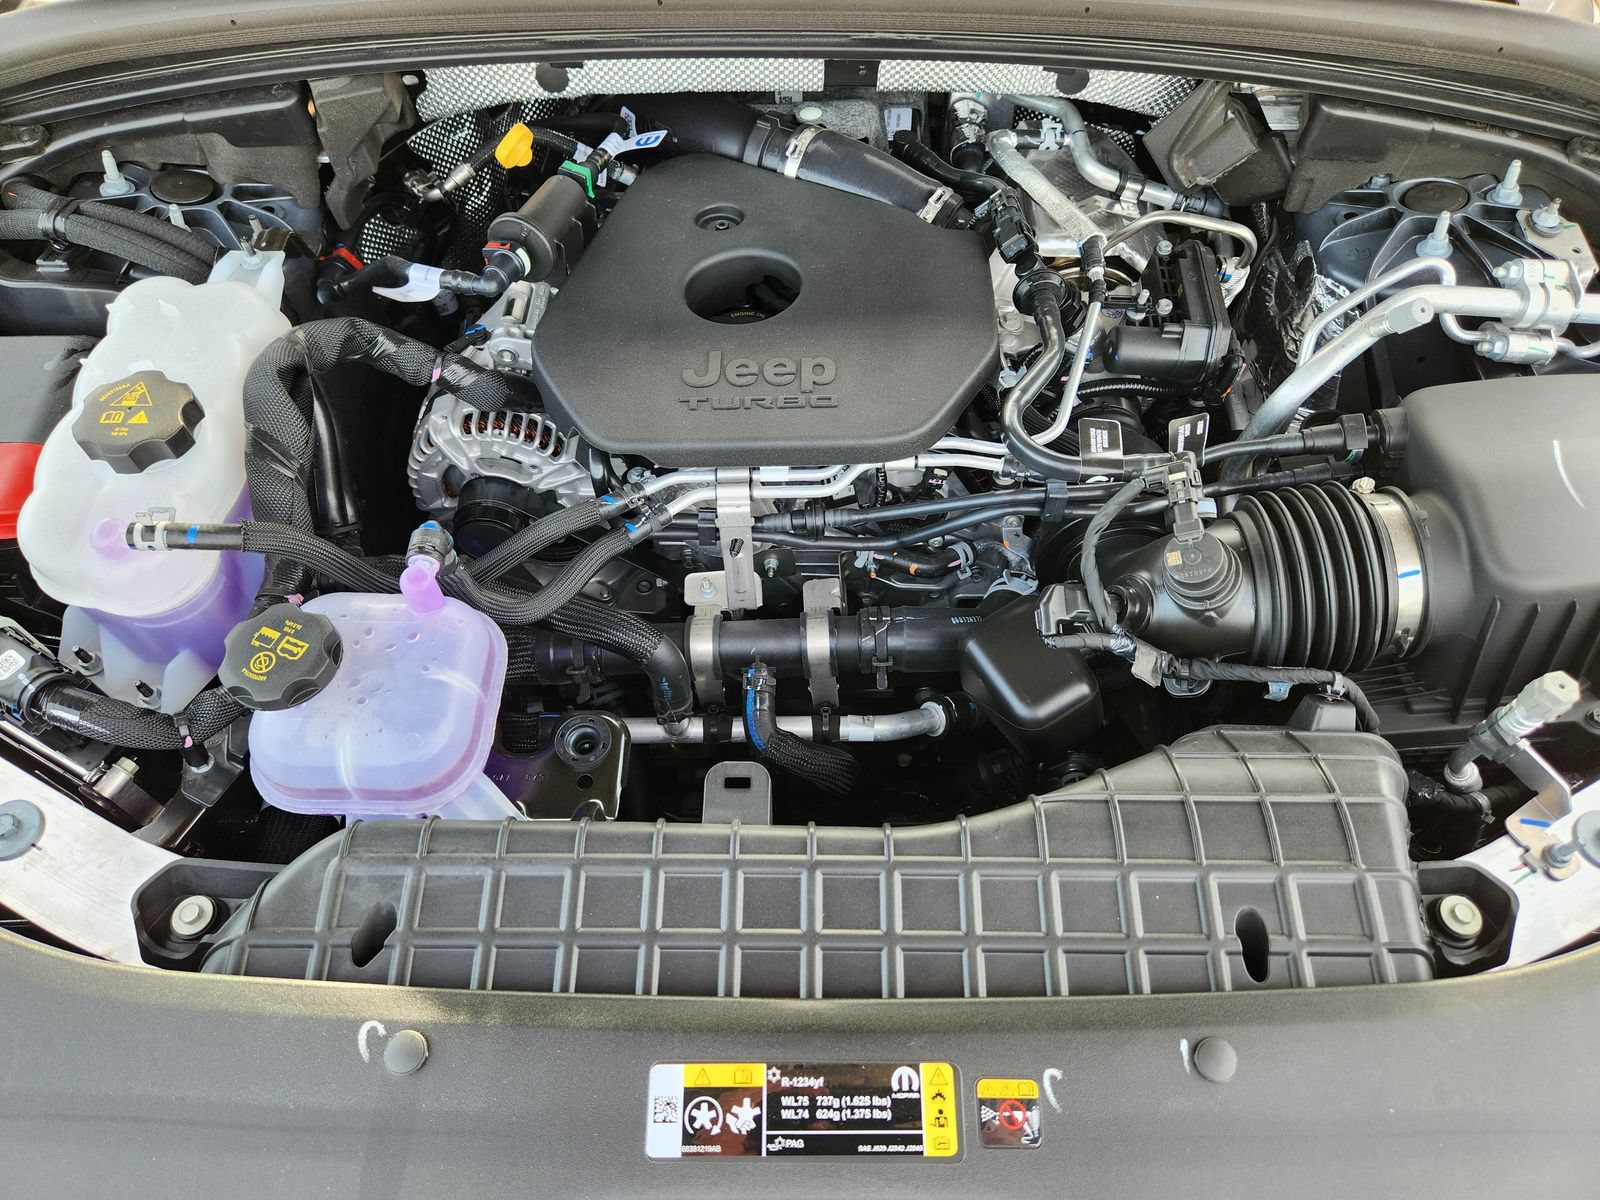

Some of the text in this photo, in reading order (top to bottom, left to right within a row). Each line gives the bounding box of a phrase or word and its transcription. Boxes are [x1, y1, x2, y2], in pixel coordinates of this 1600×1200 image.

[681, 350, 837, 393] Jeep
[678, 396, 839, 411] TURBO
[781, 1076, 825, 1088] R-1234yf
[781, 1096, 892, 1108] WL75 737g (1.625 lbs)
[781, 1109, 892, 1121] WL74 624g (1.375 lbs)
[785, 1139, 805, 1148] PAG
